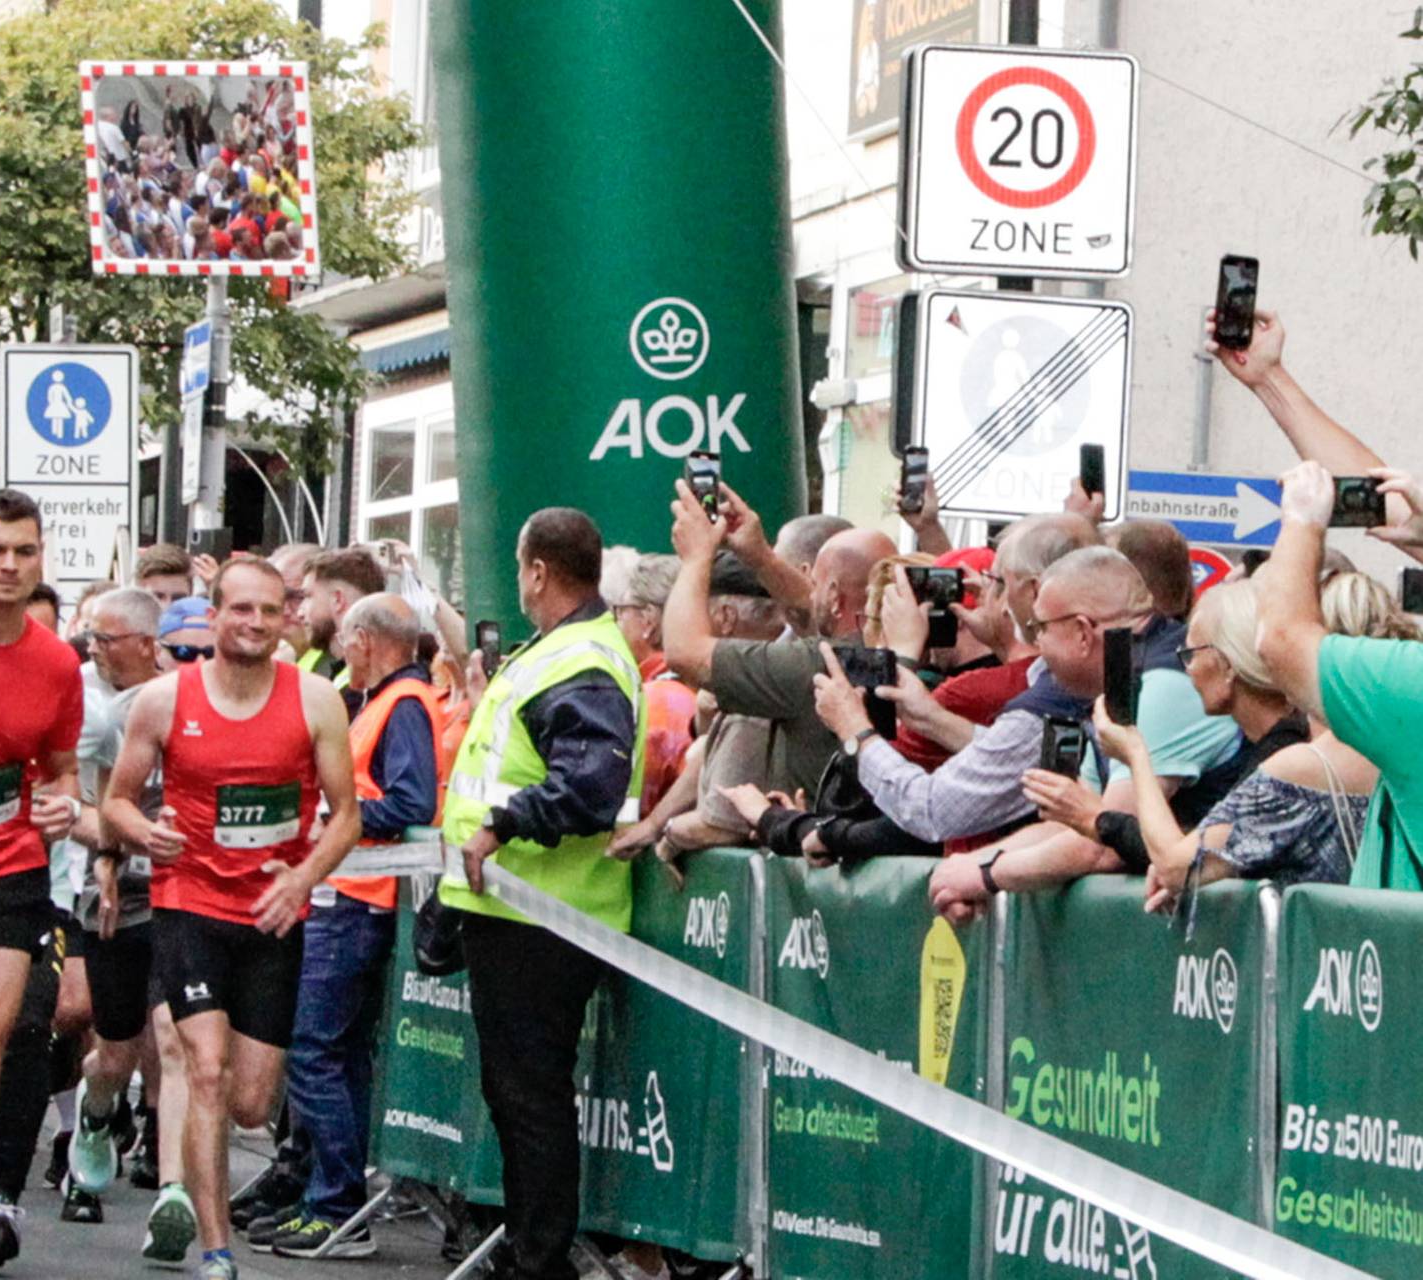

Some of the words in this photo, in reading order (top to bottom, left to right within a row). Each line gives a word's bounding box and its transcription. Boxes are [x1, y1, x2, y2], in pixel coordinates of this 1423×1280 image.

[988, 106, 1065, 169] 20
[970, 219, 1073, 254] ZONE
[588, 392, 753, 460] AOK
[36, 454, 101, 475] ZONE
[1126, 498, 1239, 518] inbahnstraße
[220, 806, 265, 823] 3777
[1173, 954, 1214, 1020] AOK
[1302, 947, 1353, 1017] AOK
[1004, 1037, 1161, 1147] Gesundheit
[1282, 1104, 1330, 1153] Bis
